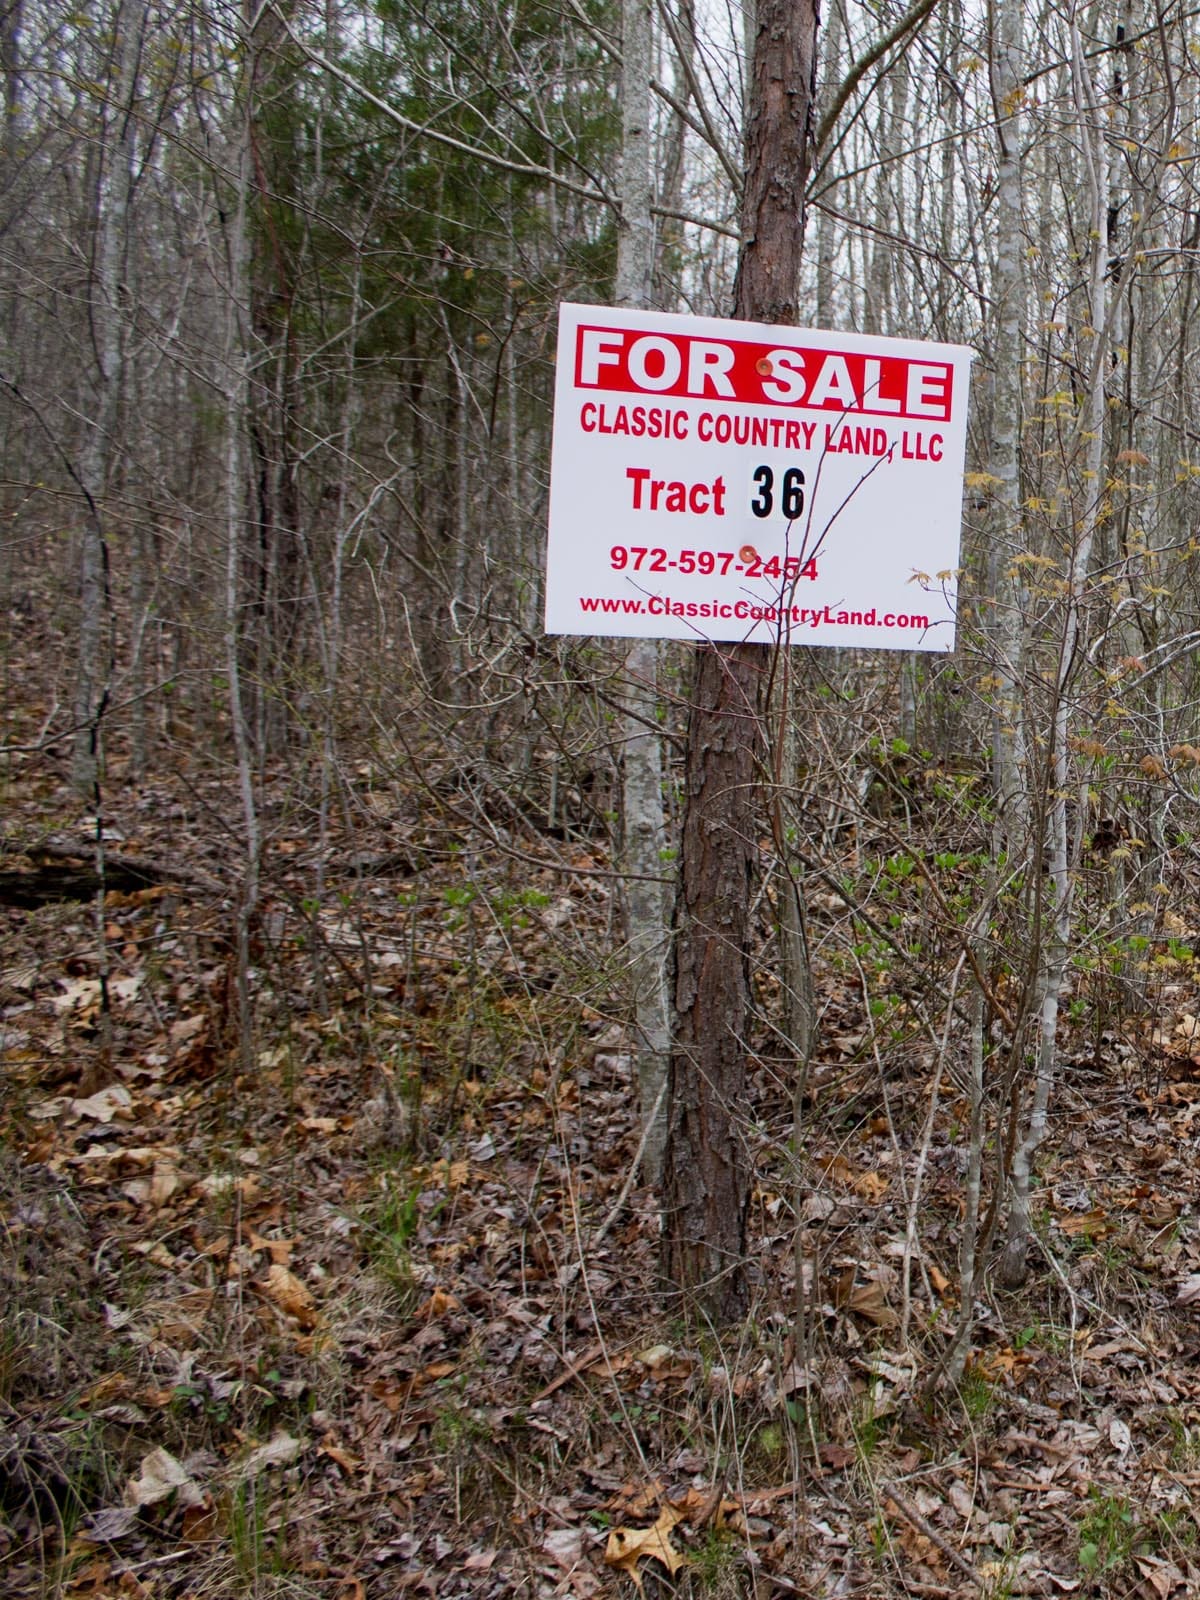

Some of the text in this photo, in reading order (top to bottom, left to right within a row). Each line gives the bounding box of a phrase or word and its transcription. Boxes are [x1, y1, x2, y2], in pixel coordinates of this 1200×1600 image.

[579, 329, 949, 419] FOR SALE
[580, 402, 943, 464] CLASSIC COUNTRY LAND, LLC
[626, 465, 806, 520] Tract 36
[610, 545, 818, 581] 972-597-2454
